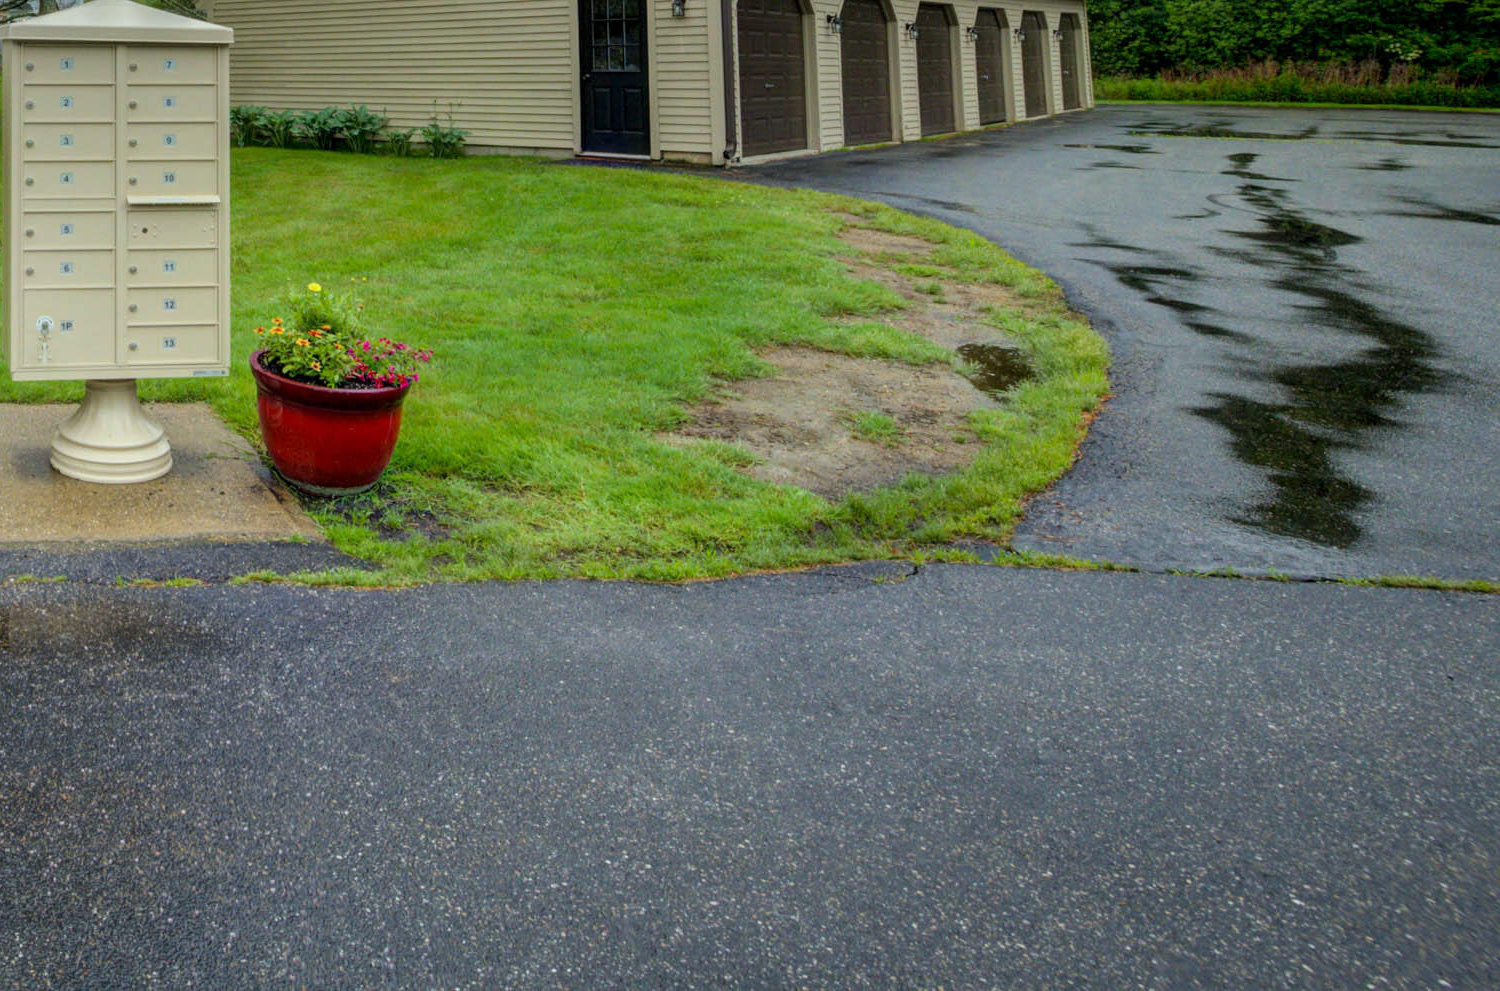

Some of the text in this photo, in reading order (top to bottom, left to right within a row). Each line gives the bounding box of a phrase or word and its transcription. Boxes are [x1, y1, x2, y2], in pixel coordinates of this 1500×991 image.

[164, 173, 175, 183] 10
[163, 262, 175, 272] 11
[164, 300, 176, 310] 12
[60, 321, 73, 331] 1P
[163, 338, 176, 348] 13
